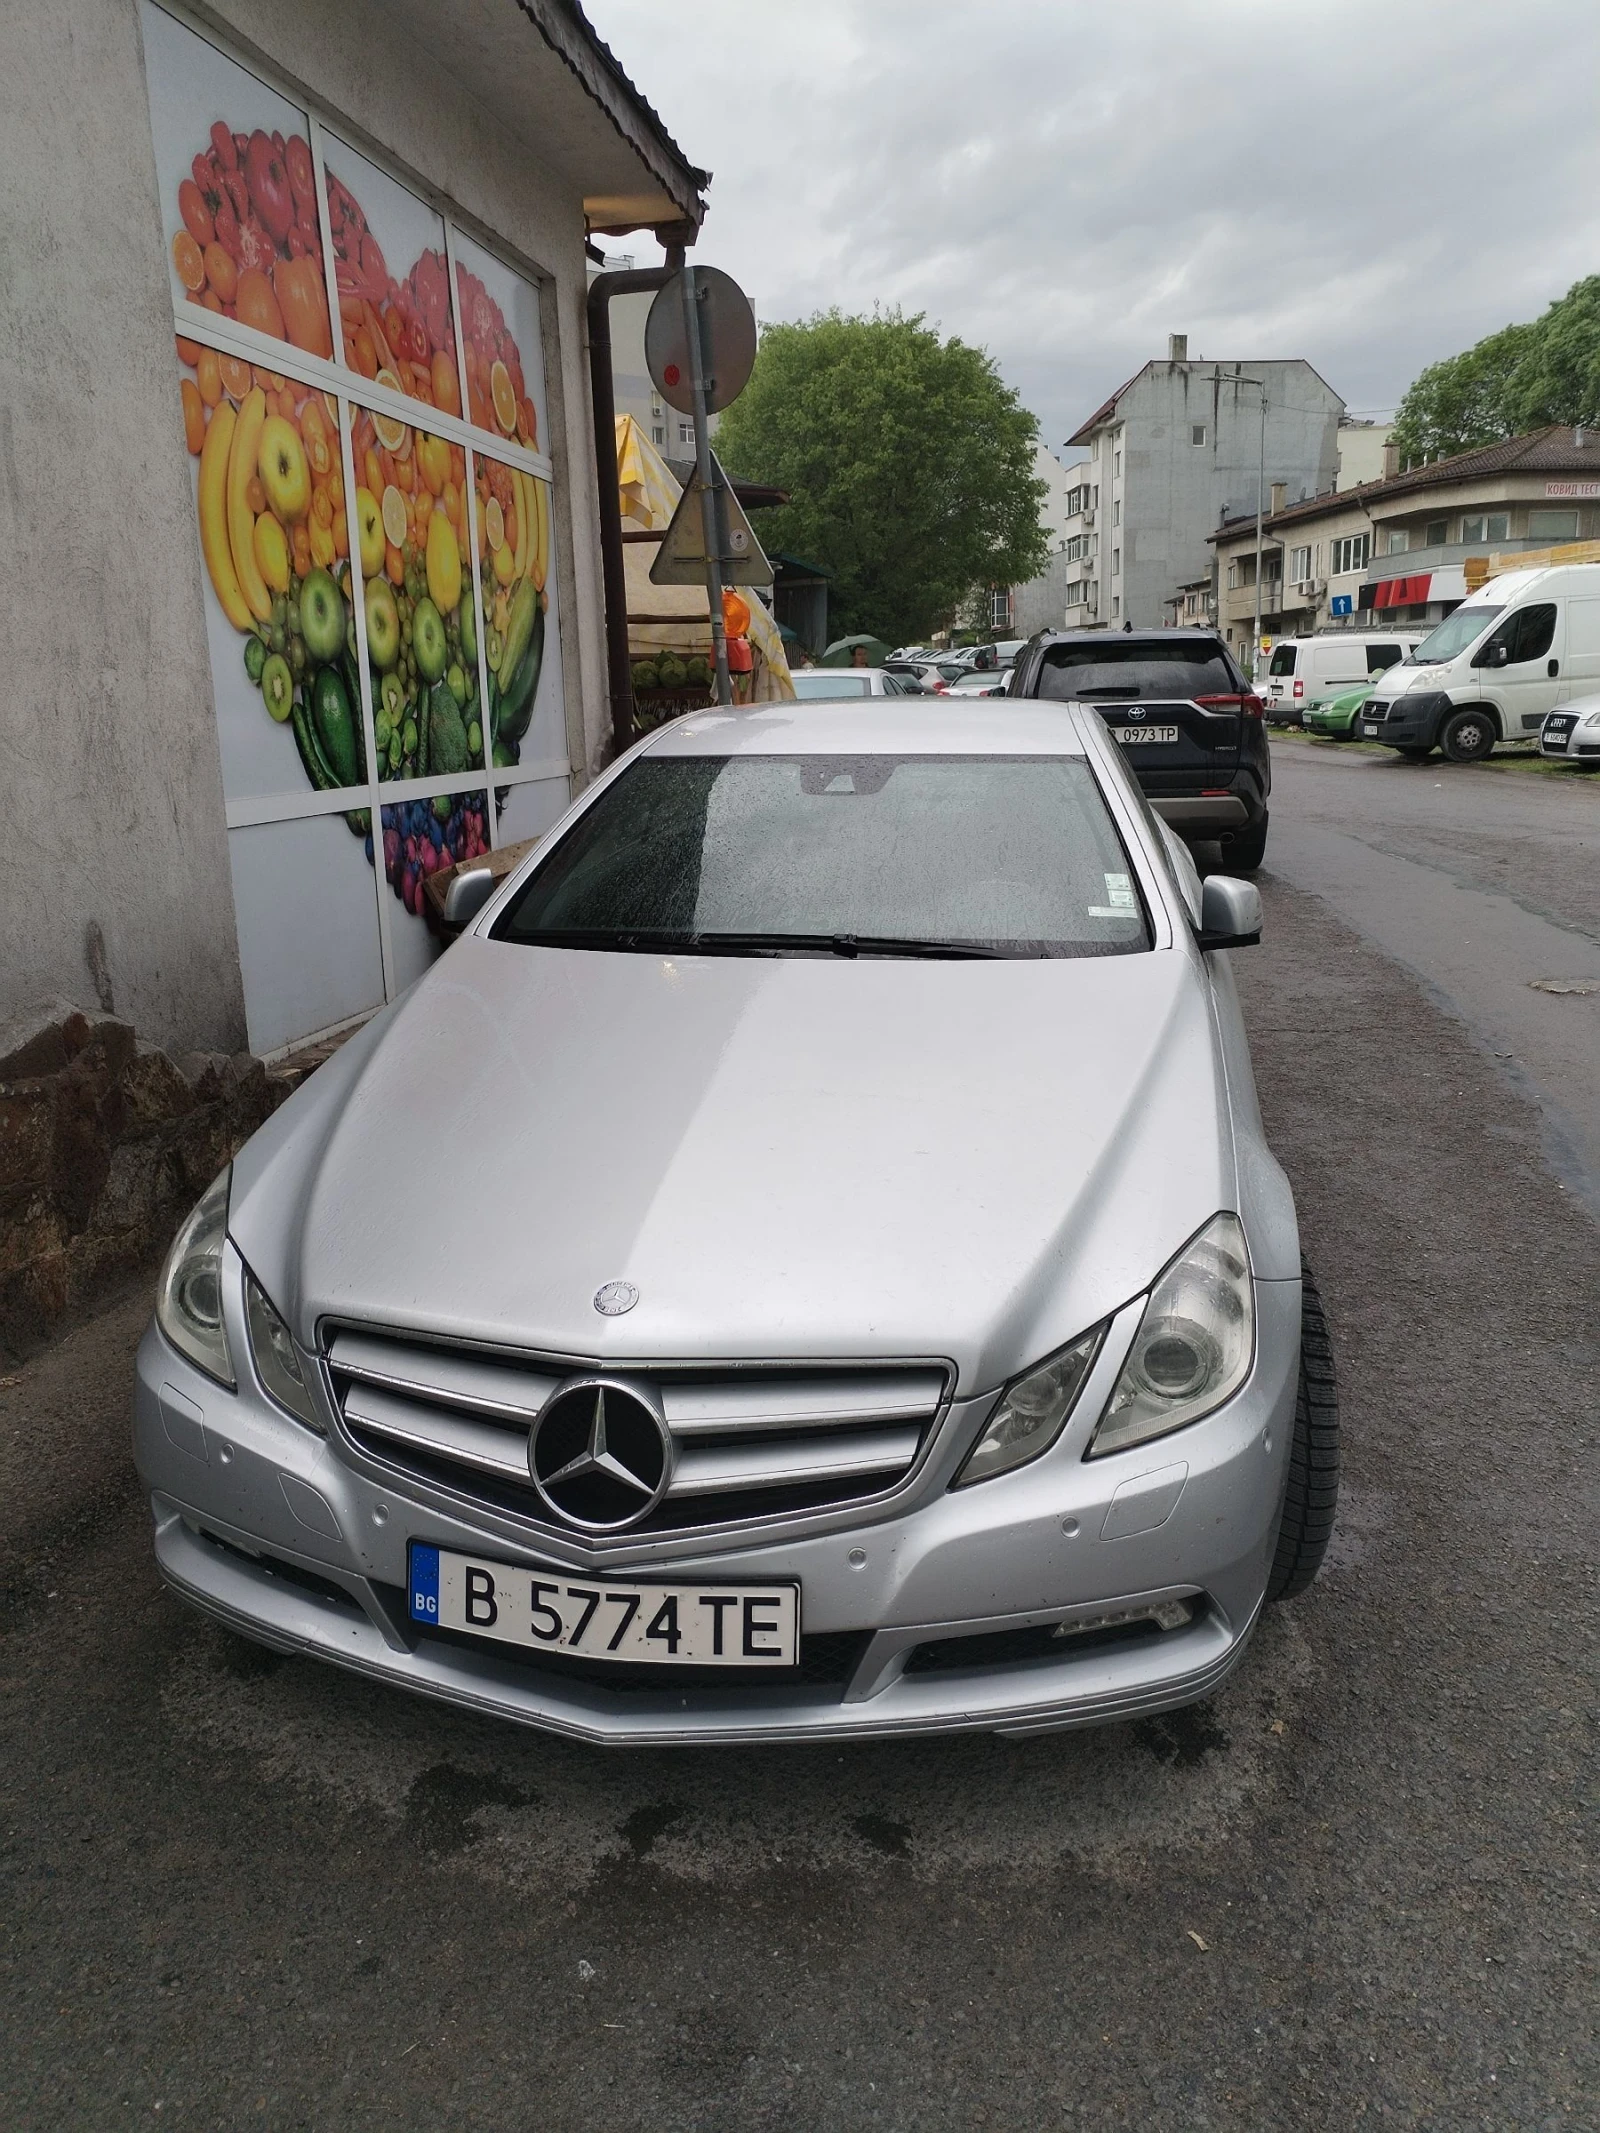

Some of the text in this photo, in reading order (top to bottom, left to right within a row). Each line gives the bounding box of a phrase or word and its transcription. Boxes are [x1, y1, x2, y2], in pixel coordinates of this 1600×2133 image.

[1547, 484, 1578, 496] КОВИД
[1123, 728, 1156, 742] 0973
[1159, 727, 1176, 741] TP
[415, 1592, 437, 1613] BG
[465, 1565, 783, 1657] B 5774 TE
